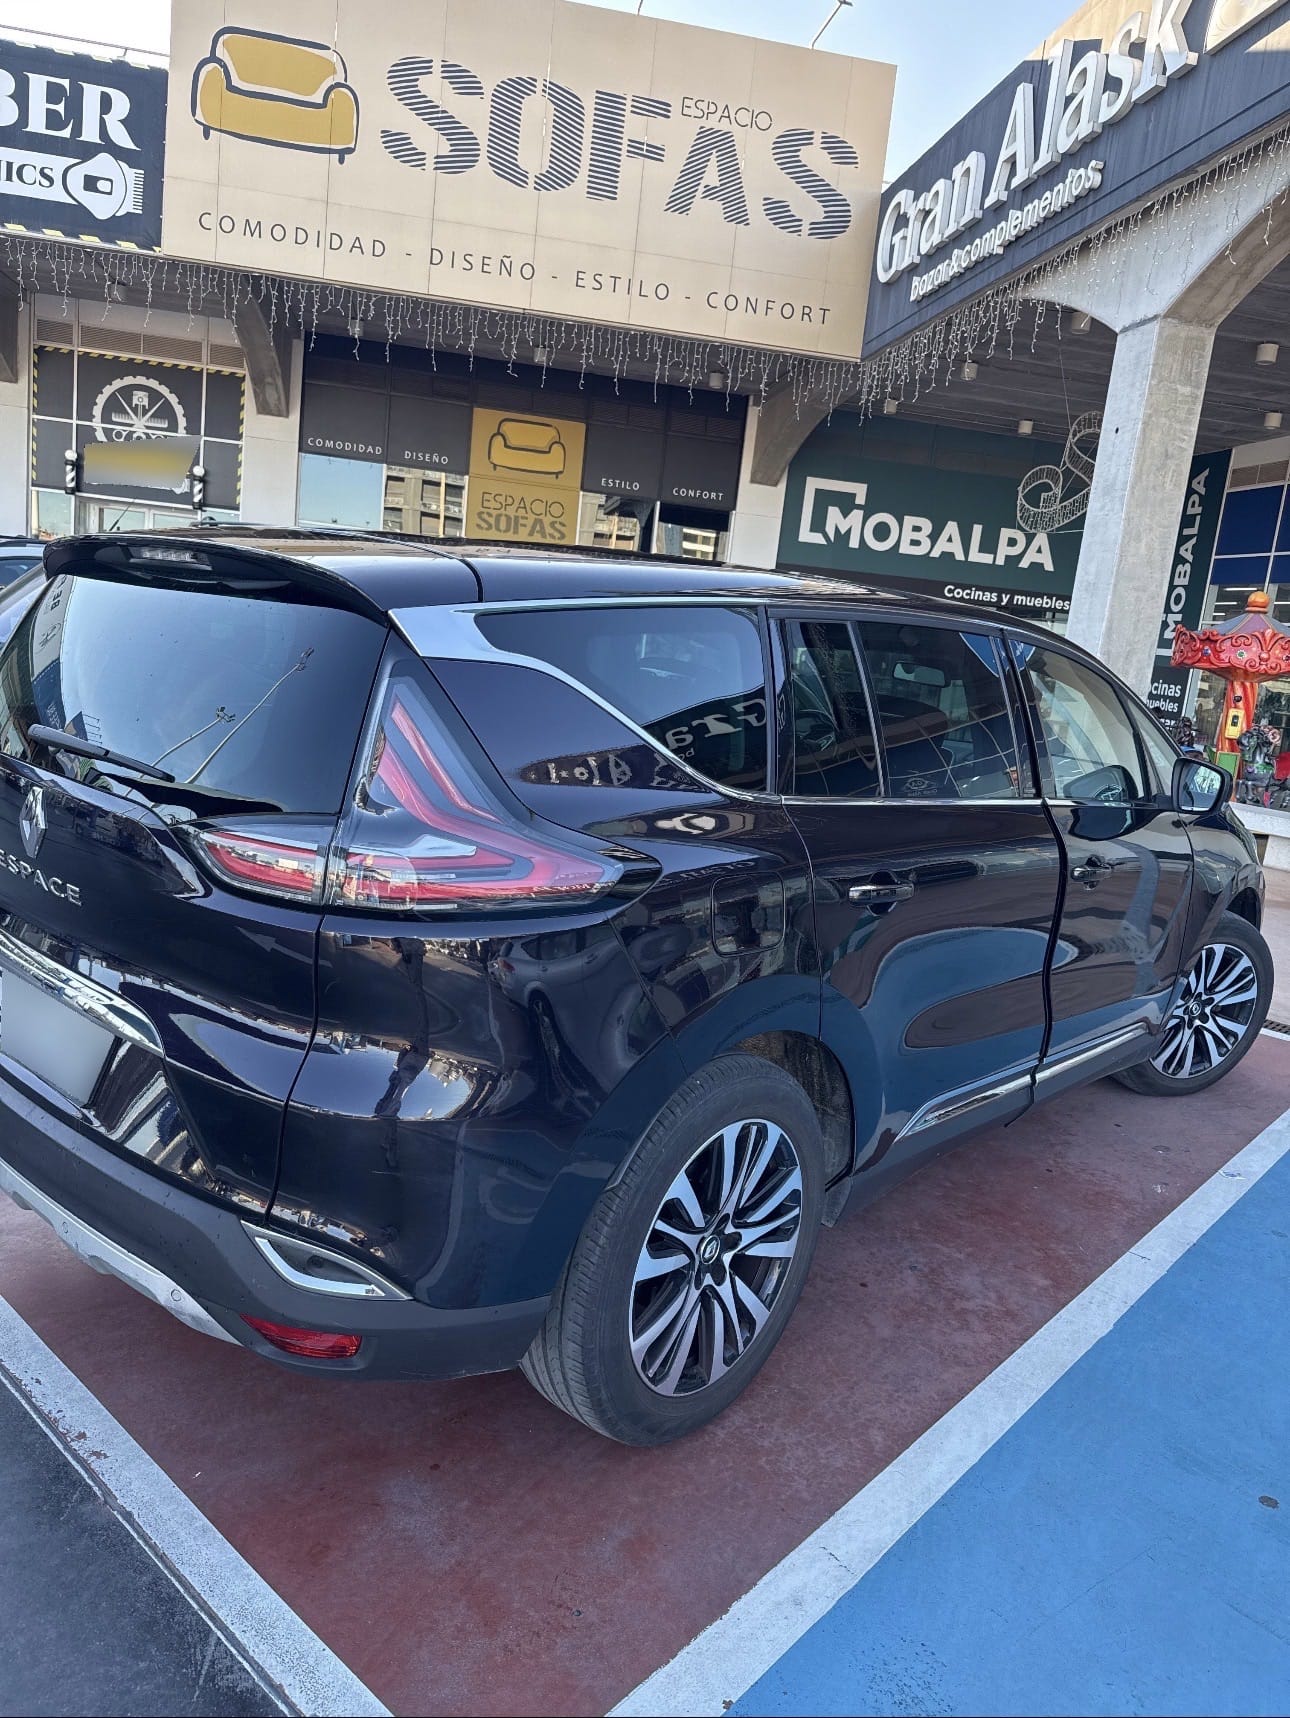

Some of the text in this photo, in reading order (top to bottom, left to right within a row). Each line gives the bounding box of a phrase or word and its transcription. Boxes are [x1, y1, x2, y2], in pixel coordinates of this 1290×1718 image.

[680, 96, 774, 132] ESPACIO
[380, 56, 859, 240] SOFAS
[0, 159, 55, 189] ICS
[876, 151, 985, 284] Gran
[198, 211, 387, 258] COMODIDAD
[429, 247, 536, 282] DISEÑO
[575, 270, 670, 301] ESTILO
[706, 291, 832, 326] CONFORT
[307, 437, 383, 455] COMODIDAD
[404, 450, 449, 465] DISEÑO
[601, 478, 640, 491] ESTILO
[672, 487, 725, 501] CONFORT
[481, 491, 565, 519] ESPACIO
[475, 511, 567, 541] SOFAS
[824, 505, 1055, 572] MOBALPA
[1163, 467, 1210, 639] MOBALPA
[943, 585, 1071, 610] Cocinas y muebles
